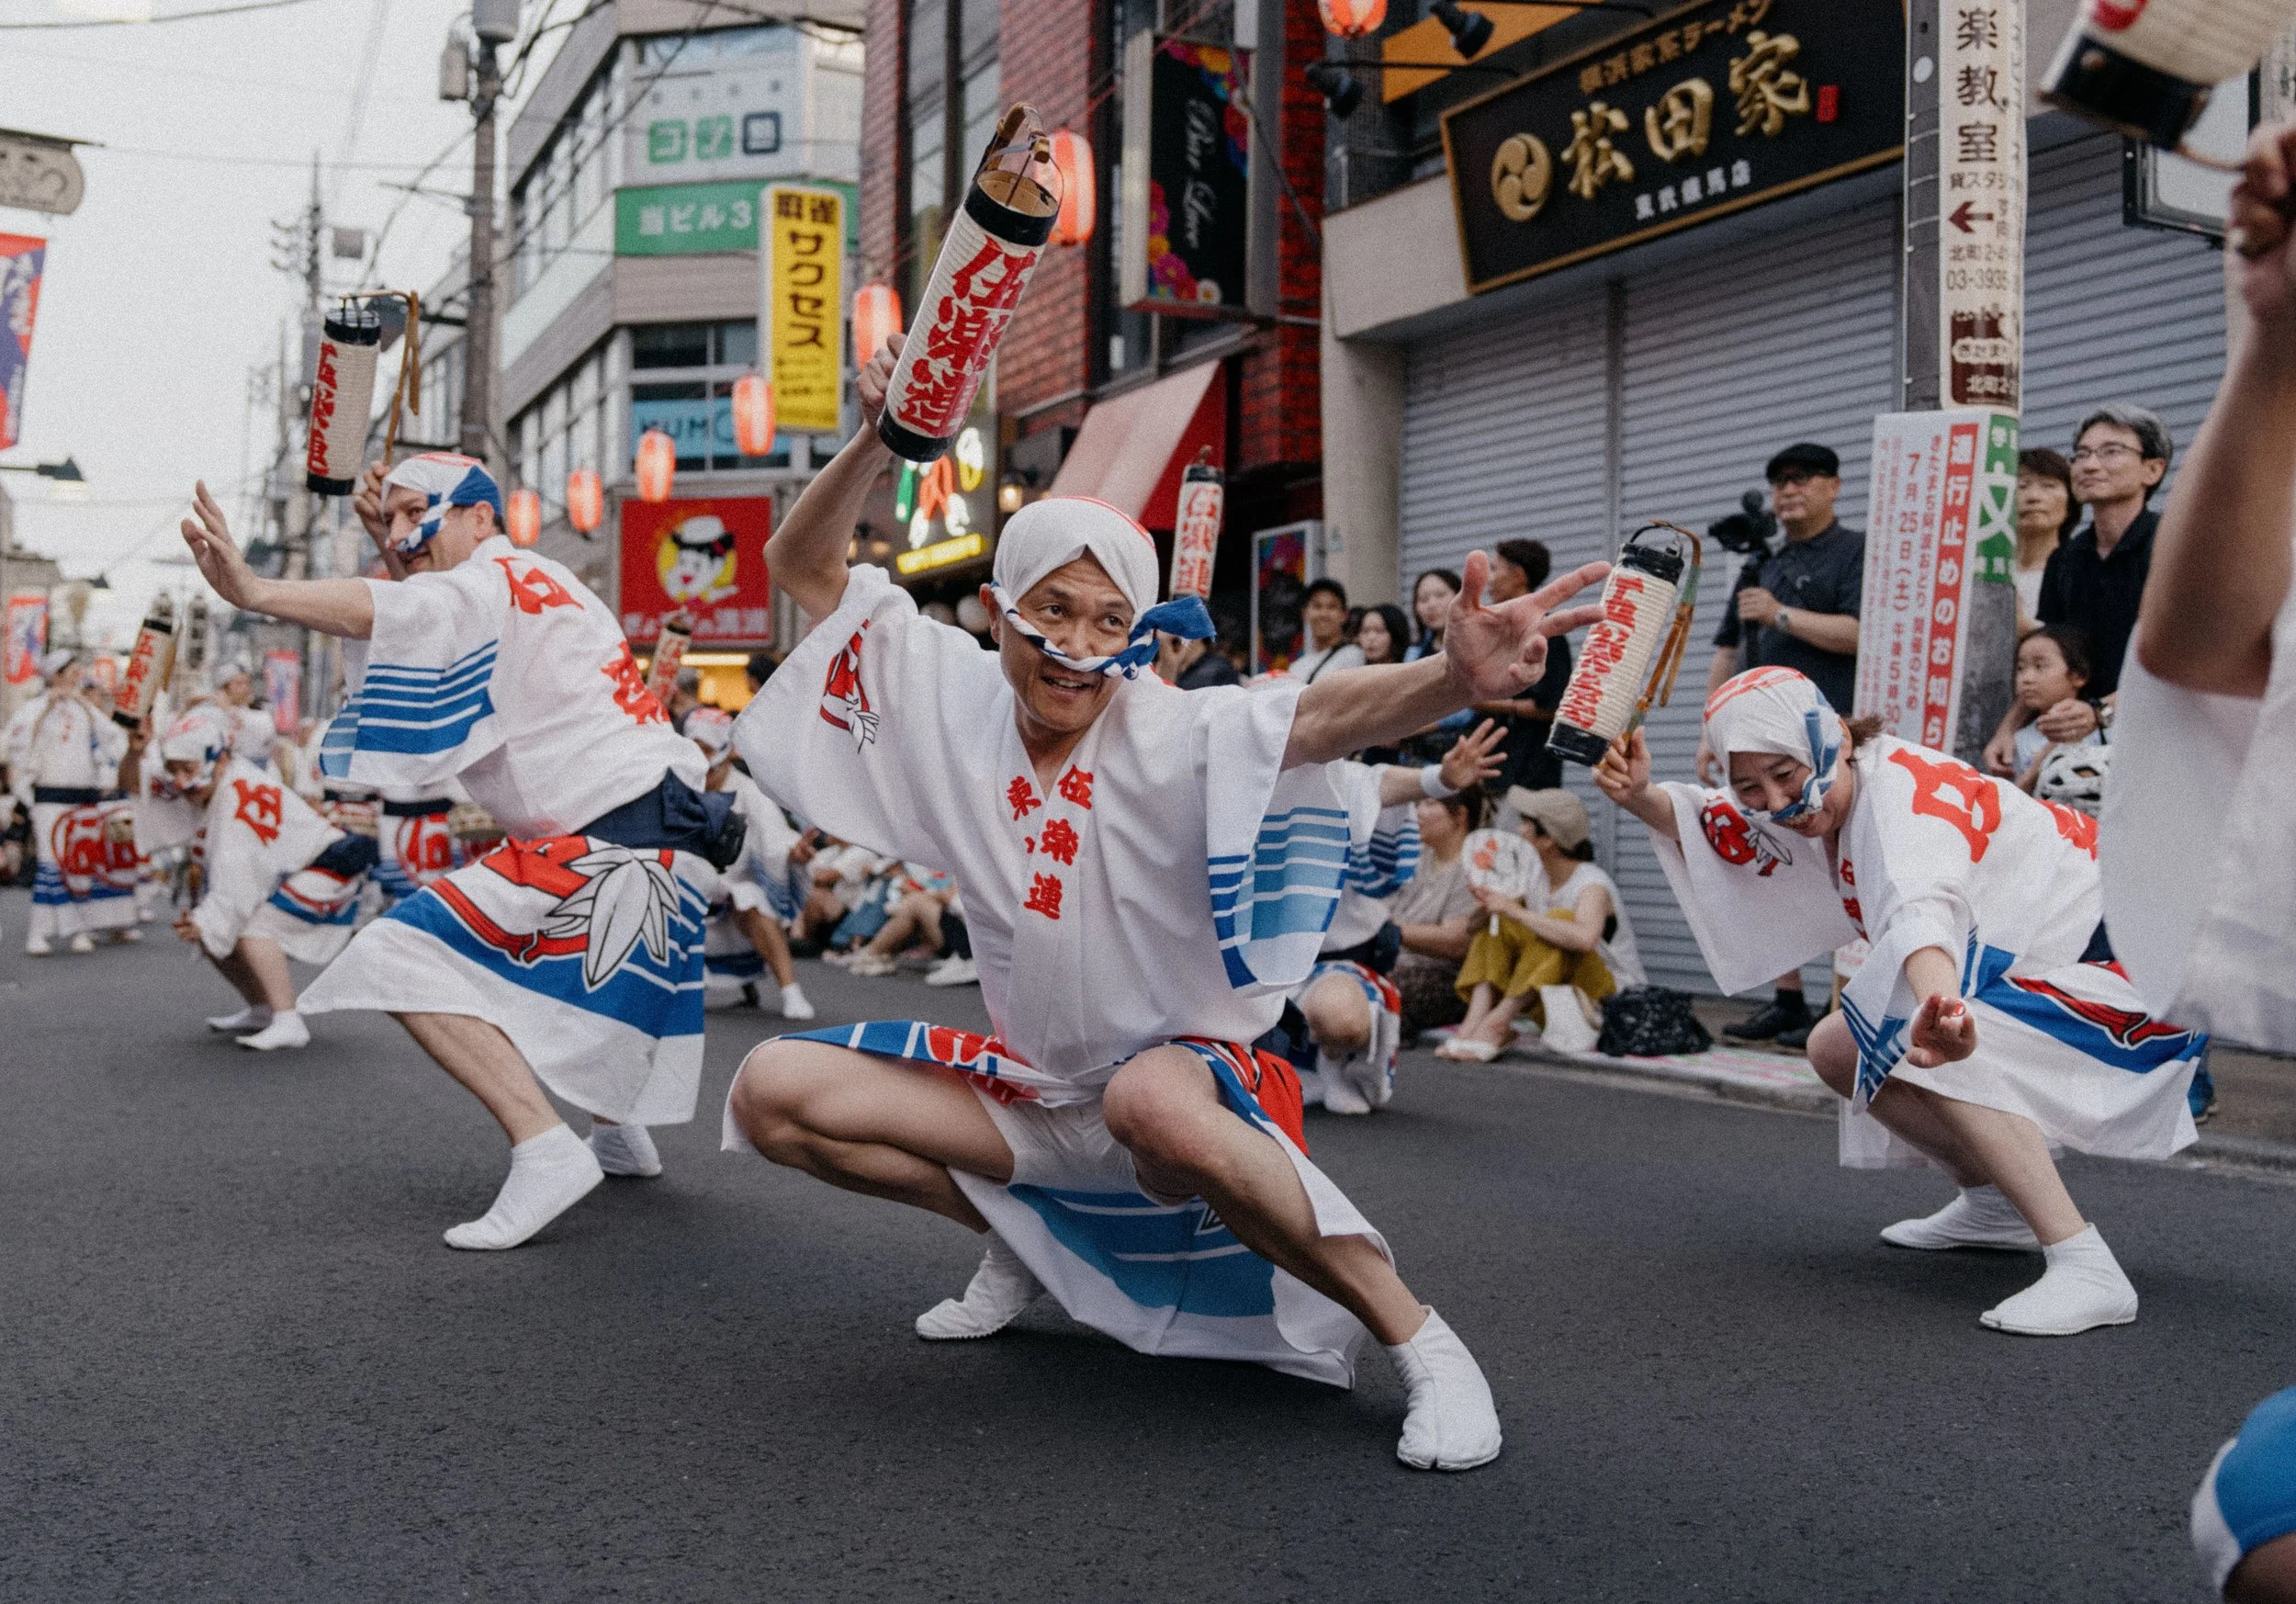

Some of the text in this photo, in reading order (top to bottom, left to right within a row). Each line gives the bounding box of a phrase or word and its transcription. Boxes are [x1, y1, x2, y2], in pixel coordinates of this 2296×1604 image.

[1561, 29, 1810, 199] 松田家
[1957, 8, 1998, 163] 楽教室
[787, 230, 827, 350] サクセス
[1023, 763, 1095, 921] 伍楽連
